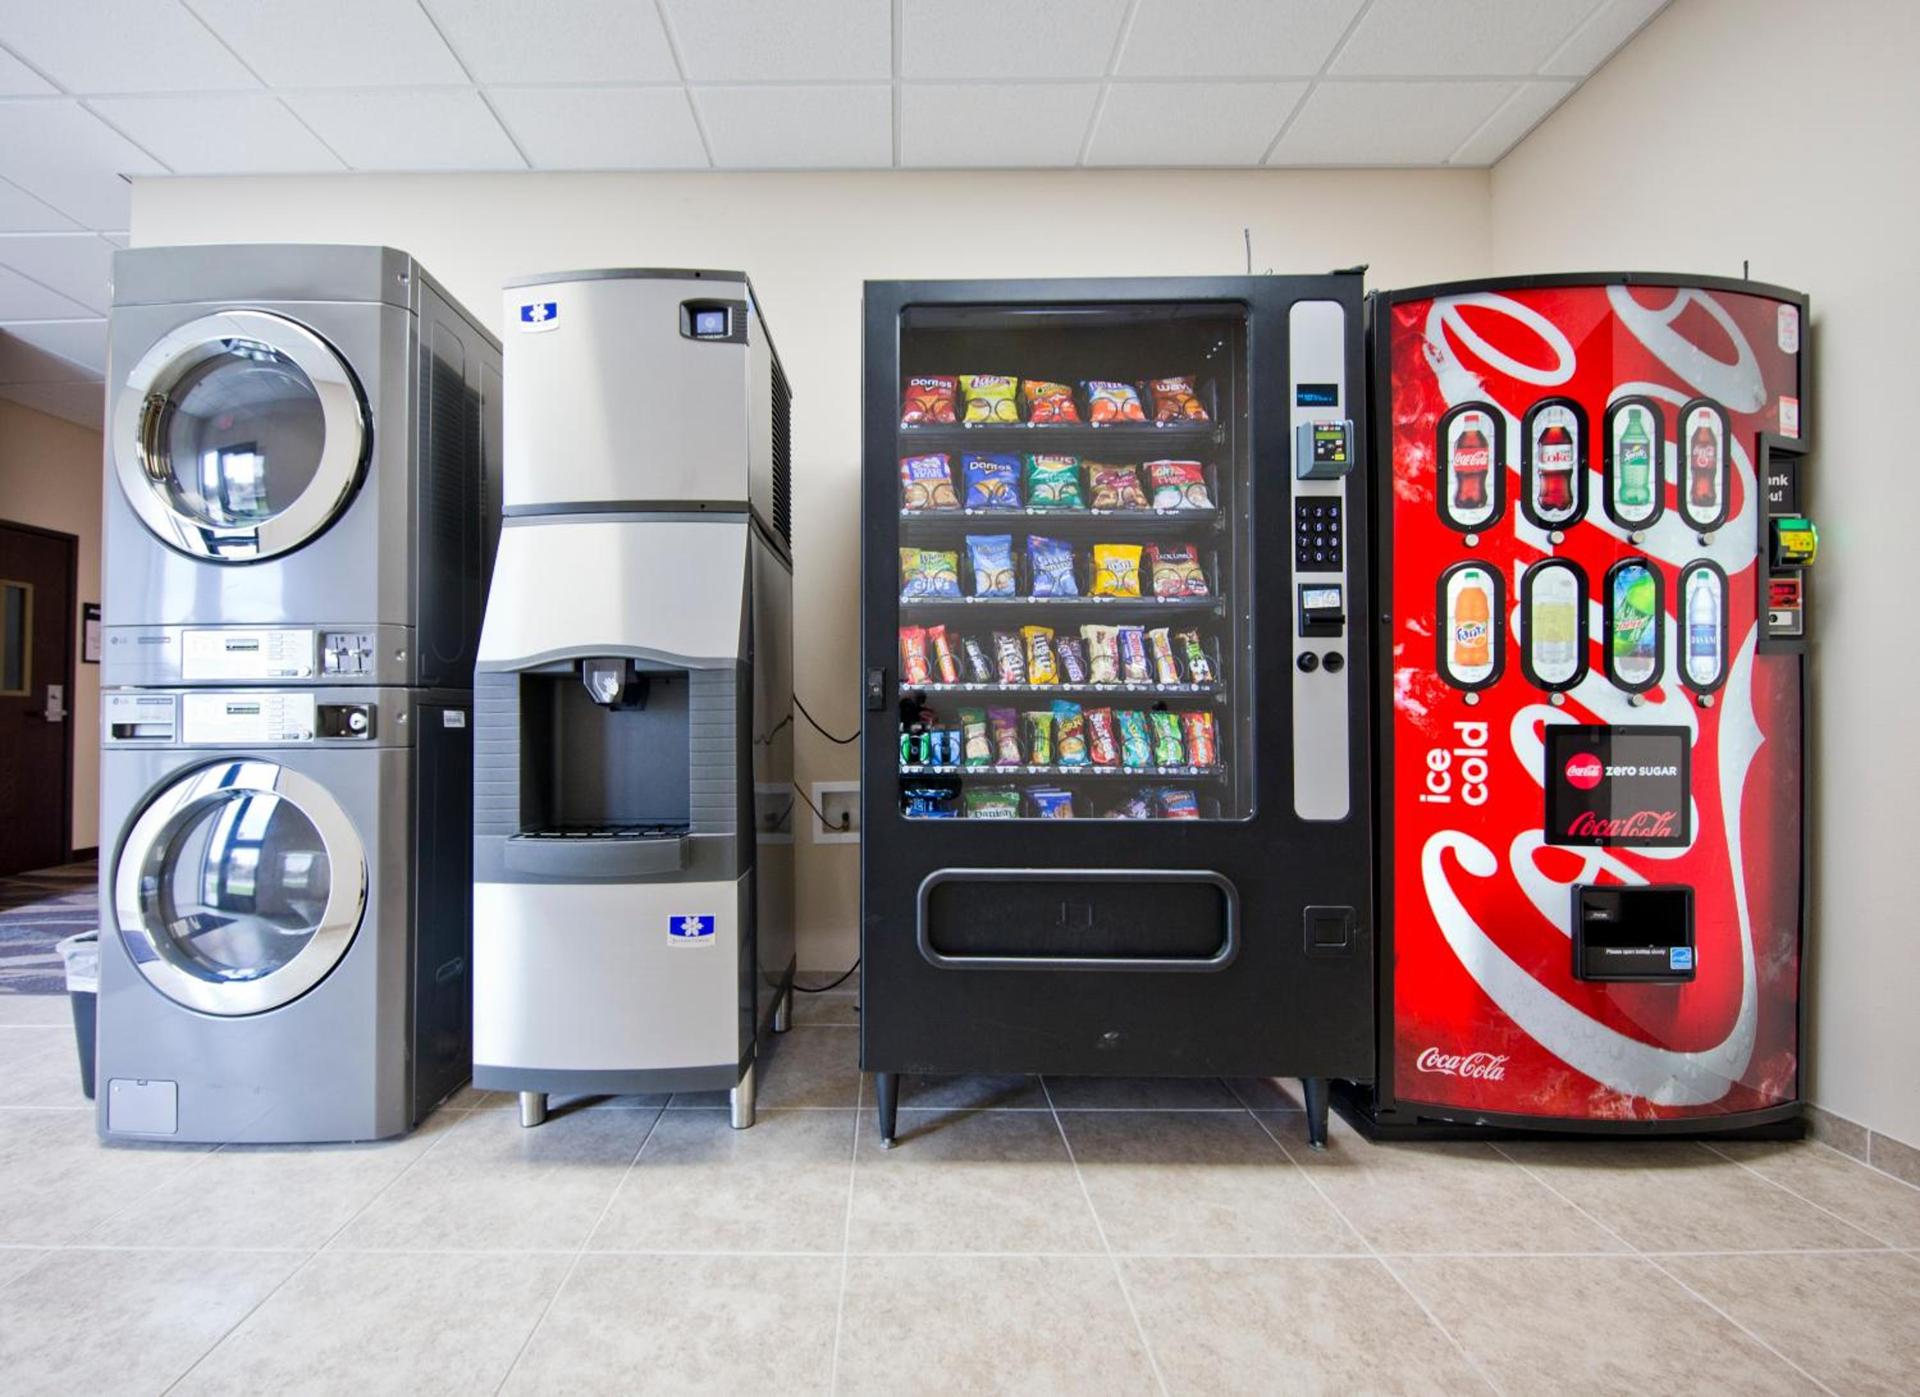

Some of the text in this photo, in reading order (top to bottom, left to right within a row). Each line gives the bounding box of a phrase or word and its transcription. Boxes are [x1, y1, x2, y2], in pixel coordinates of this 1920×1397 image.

[1419, 748, 1452, 804] ice
[1453, 721, 1489, 806] cold
[1605, 766, 1637, 777] zero
[1638, 766, 1677, 776] SUGAR
[1416, 1046, 1510, 1081] Coca-Cola
